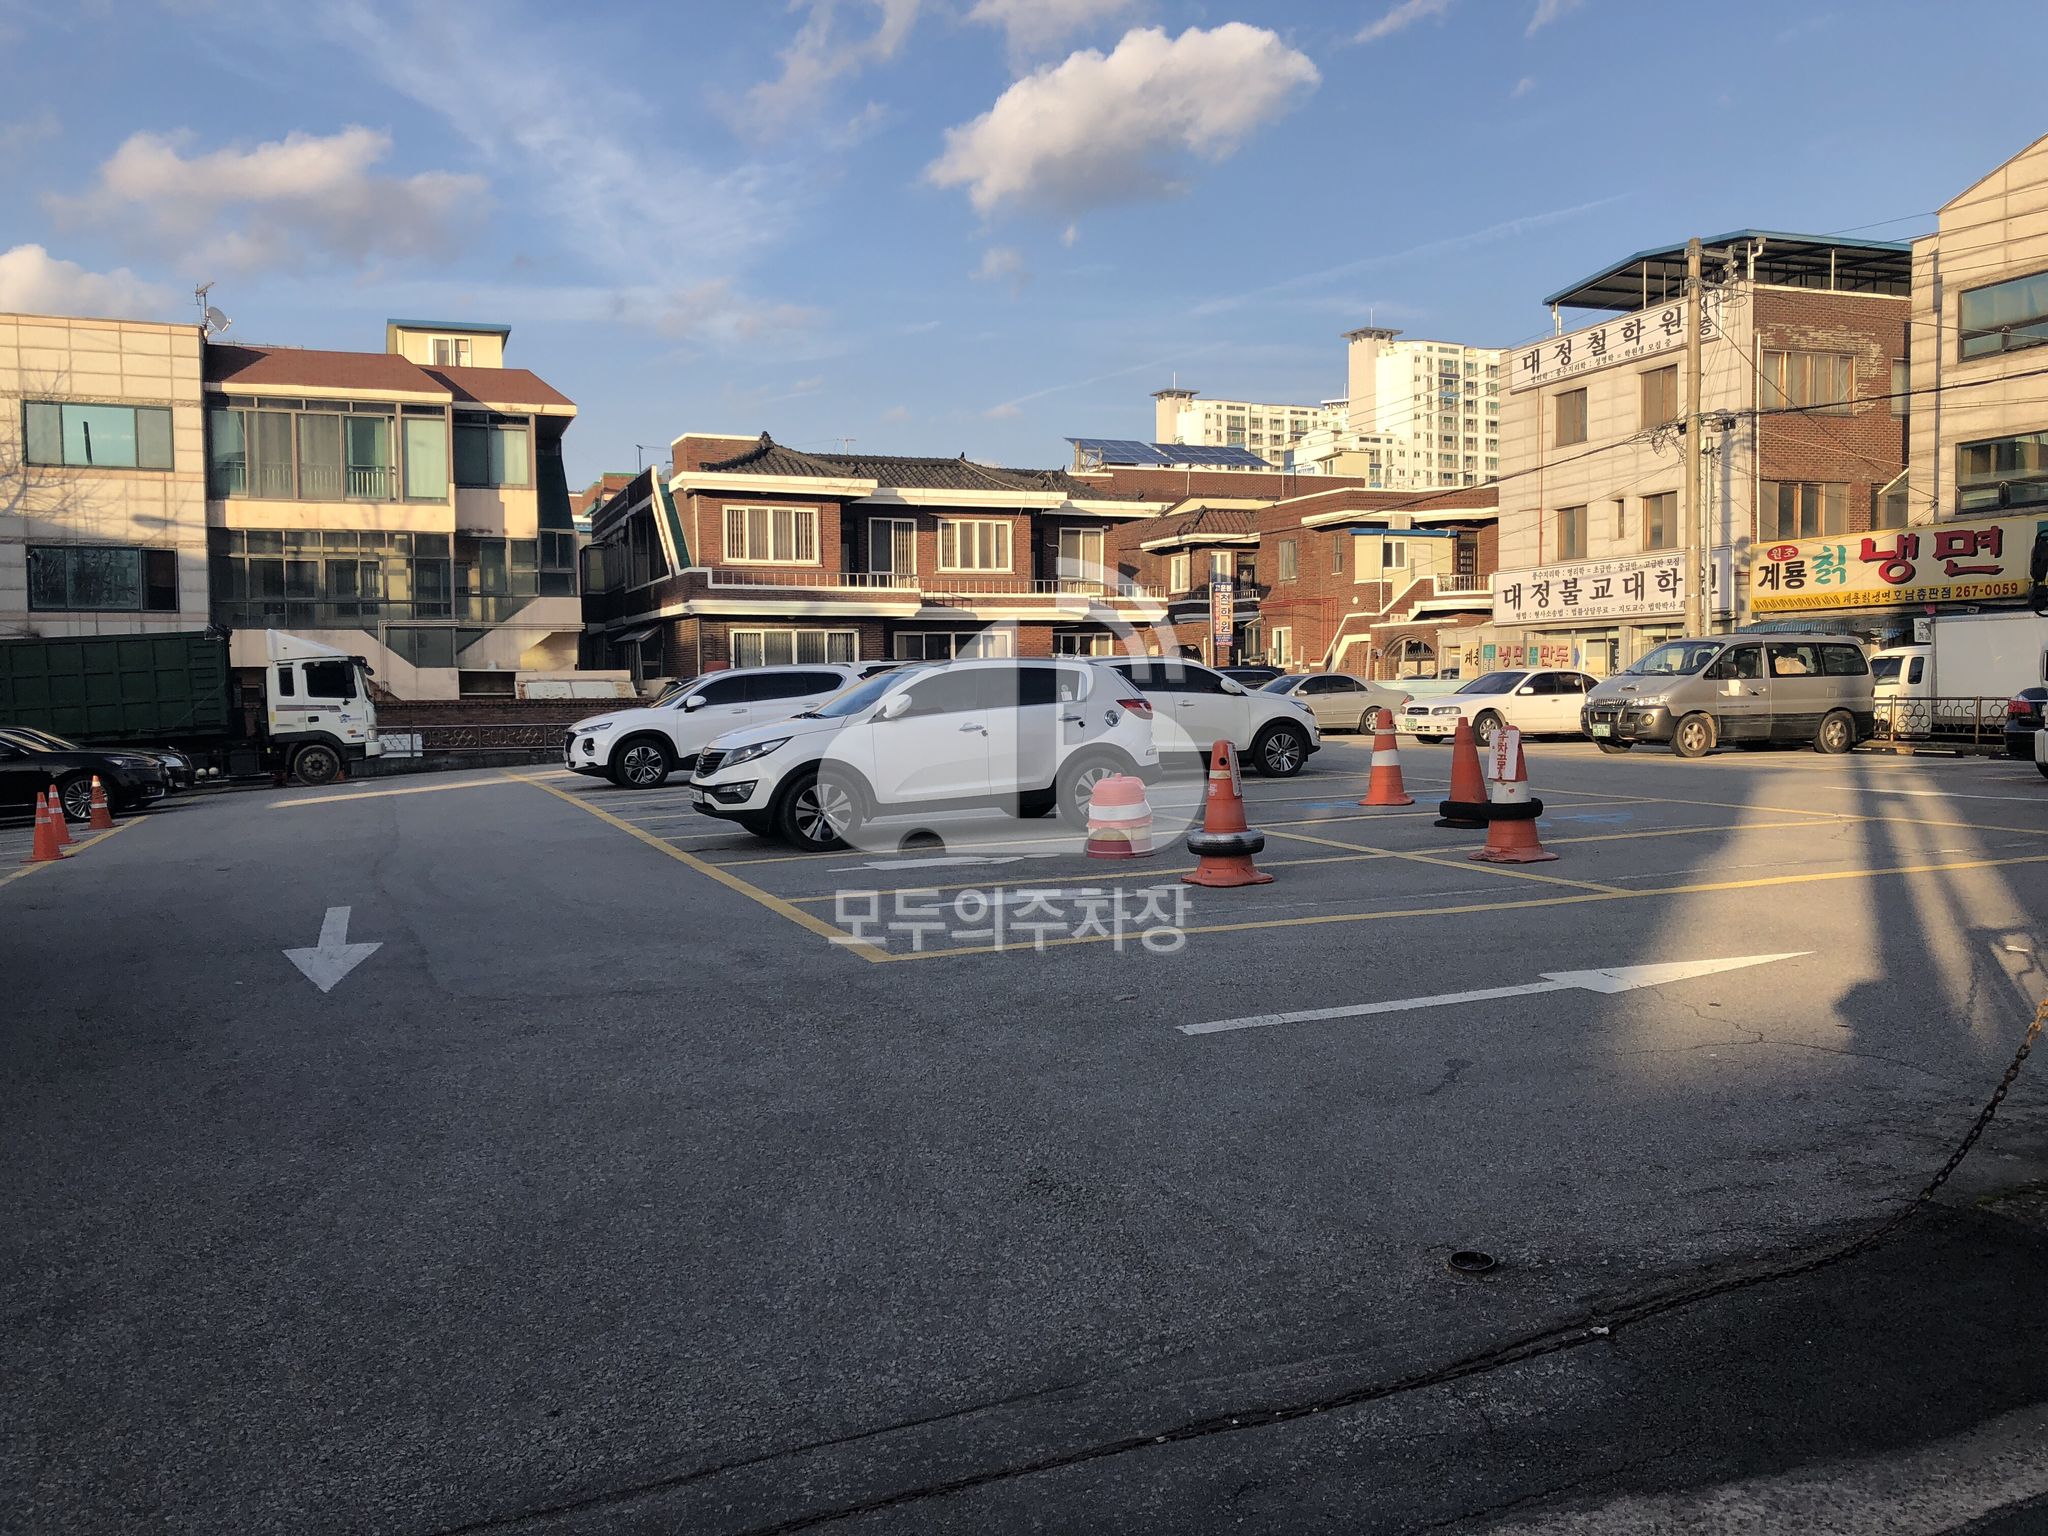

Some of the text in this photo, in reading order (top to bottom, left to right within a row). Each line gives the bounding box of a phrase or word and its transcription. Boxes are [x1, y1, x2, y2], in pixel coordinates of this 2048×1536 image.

[1522, 307, 1683, 374] 대정철학원
[1555, 362, 1586, 377] 풍수지리학
[1647, 340, 1662, 351] 모집
[1664, 338, 1672, 347] 중
[1758, 525, 2005, 591] 계룡 칡 냉면
[1770, 547, 1796, 561] 원조
[1531, 569, 1561, 580] 풍수지리학
[1592, 564, 1612, 574] 초급반
[1666, 556, 1681, 567] 모집
[1893, 586, 1951, 602] 호남총판점
[1955, 582, 2018, 598] 267-0059
[1220, 593, 1232, 633] 철학원
[1618, 603, 1645, 613] 지도교수
[1540, 644, 1569, 668] 만두
